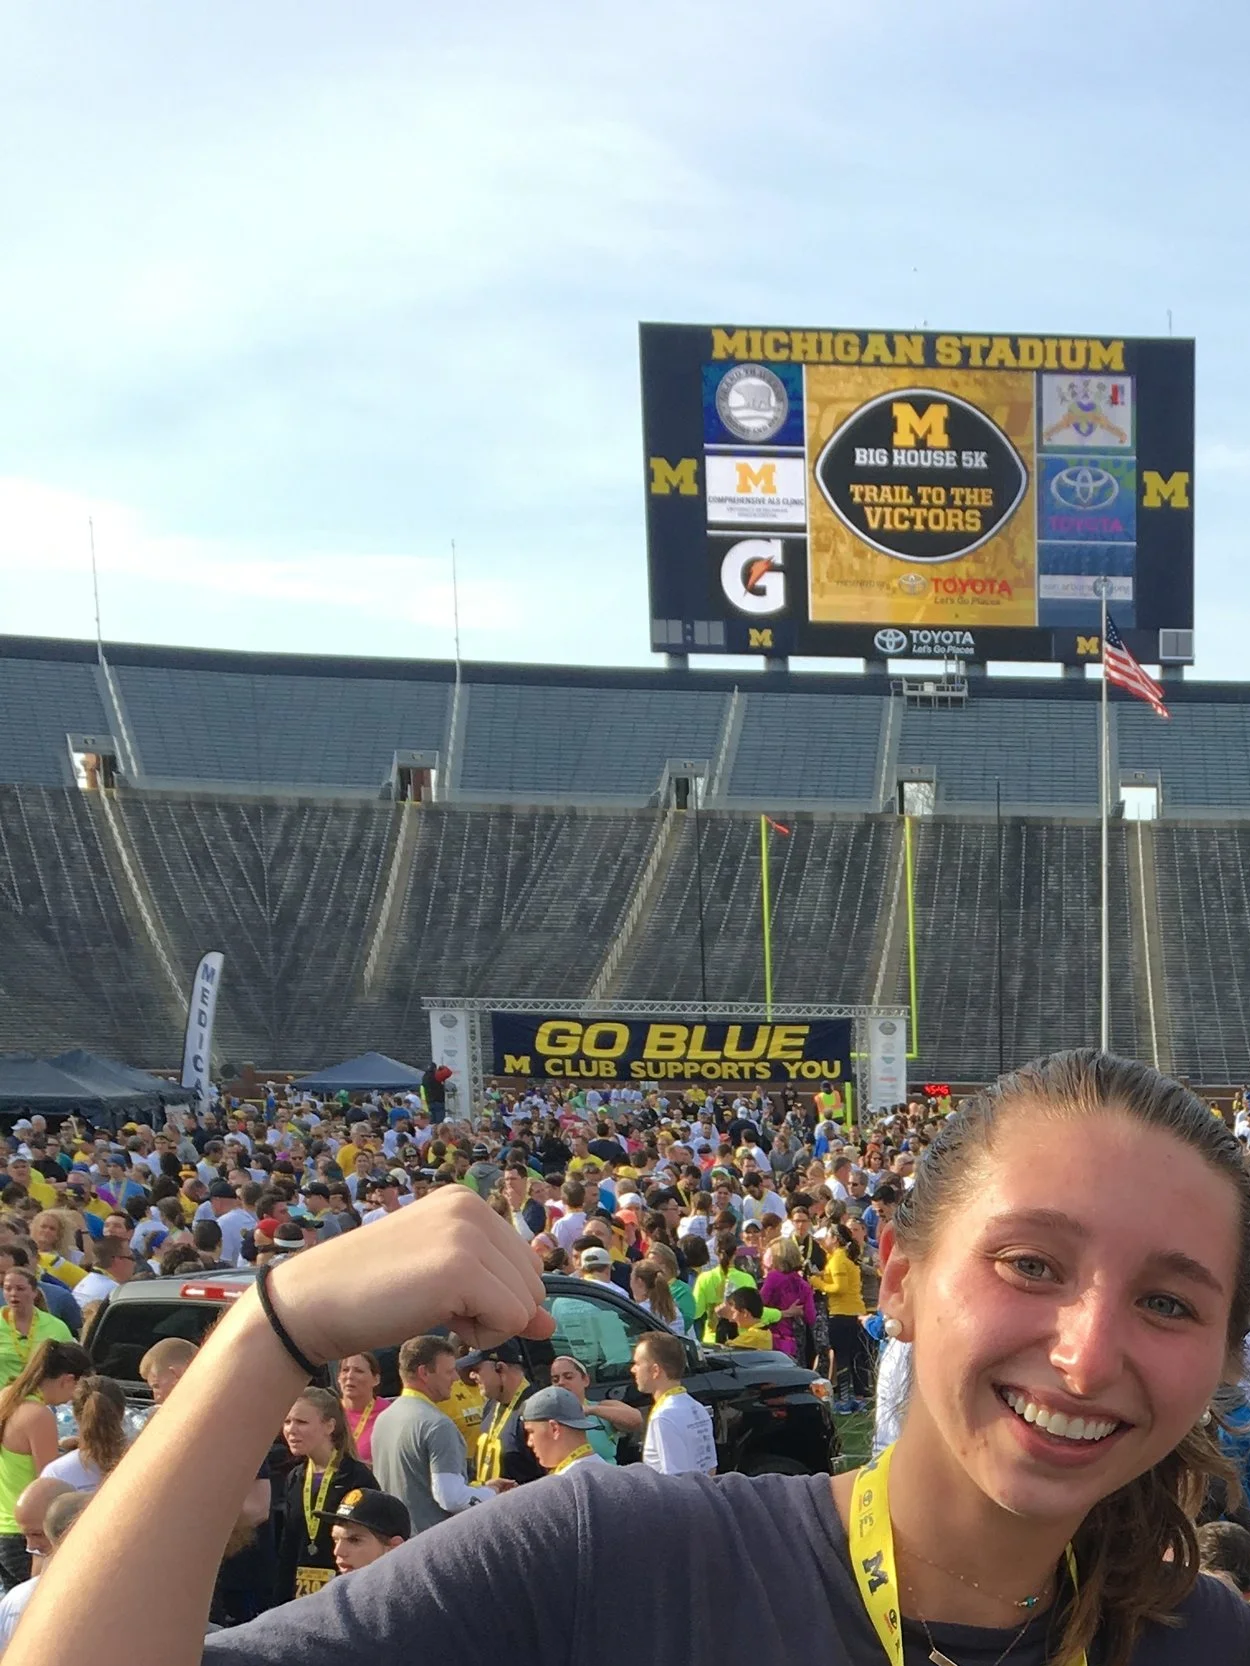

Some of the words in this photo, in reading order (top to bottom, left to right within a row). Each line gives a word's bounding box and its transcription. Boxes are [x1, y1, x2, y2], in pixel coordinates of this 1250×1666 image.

[711, 328, 925, 365] MICHIGAN
[935, 335, 1126, 371] STADIUM
[892, 402, 950, 448] M
[854, 447, 888, 467] BIG
[892, 448, 958, 468] HOUSE
[961, 450, 988, 469] 5K
[651, 457, 698, 495] M
[735, 462, 777, 494] M
[849, 483, 914, 505] TRAIL
[917, 485, 946, 505] TO
[950, 487, 993, 507] THE
[1142, 470, 1190, 508] M
[863, 506, 982, 532] VICTORS
[1049, 514, 1124, 533] TOYOTA
[720, 538, 785, 614] G
[931, 577, 1012, 597] TOYOTA
[749, 628, 773, 647] M
[909, 629, 975, 645] TOYOTA
[912, 644, 932, 654] Let's
[933, 645, 946, 655] Go
[946, 645, 975, 655] Places
[1076, 636, 1100, 655] M
[192, 963, 216, 1110] MEDICA
[535, 1020, 630, 1058] GO
[643, 1023, 810, 1060] BLUE
[504, 1055, 531, 1075] M
[544, 1058, 618, 1078] CLUB
[630, 1061, 772, 1080] SUPPORTS
[782, 1060, 841, 1080] YOU
